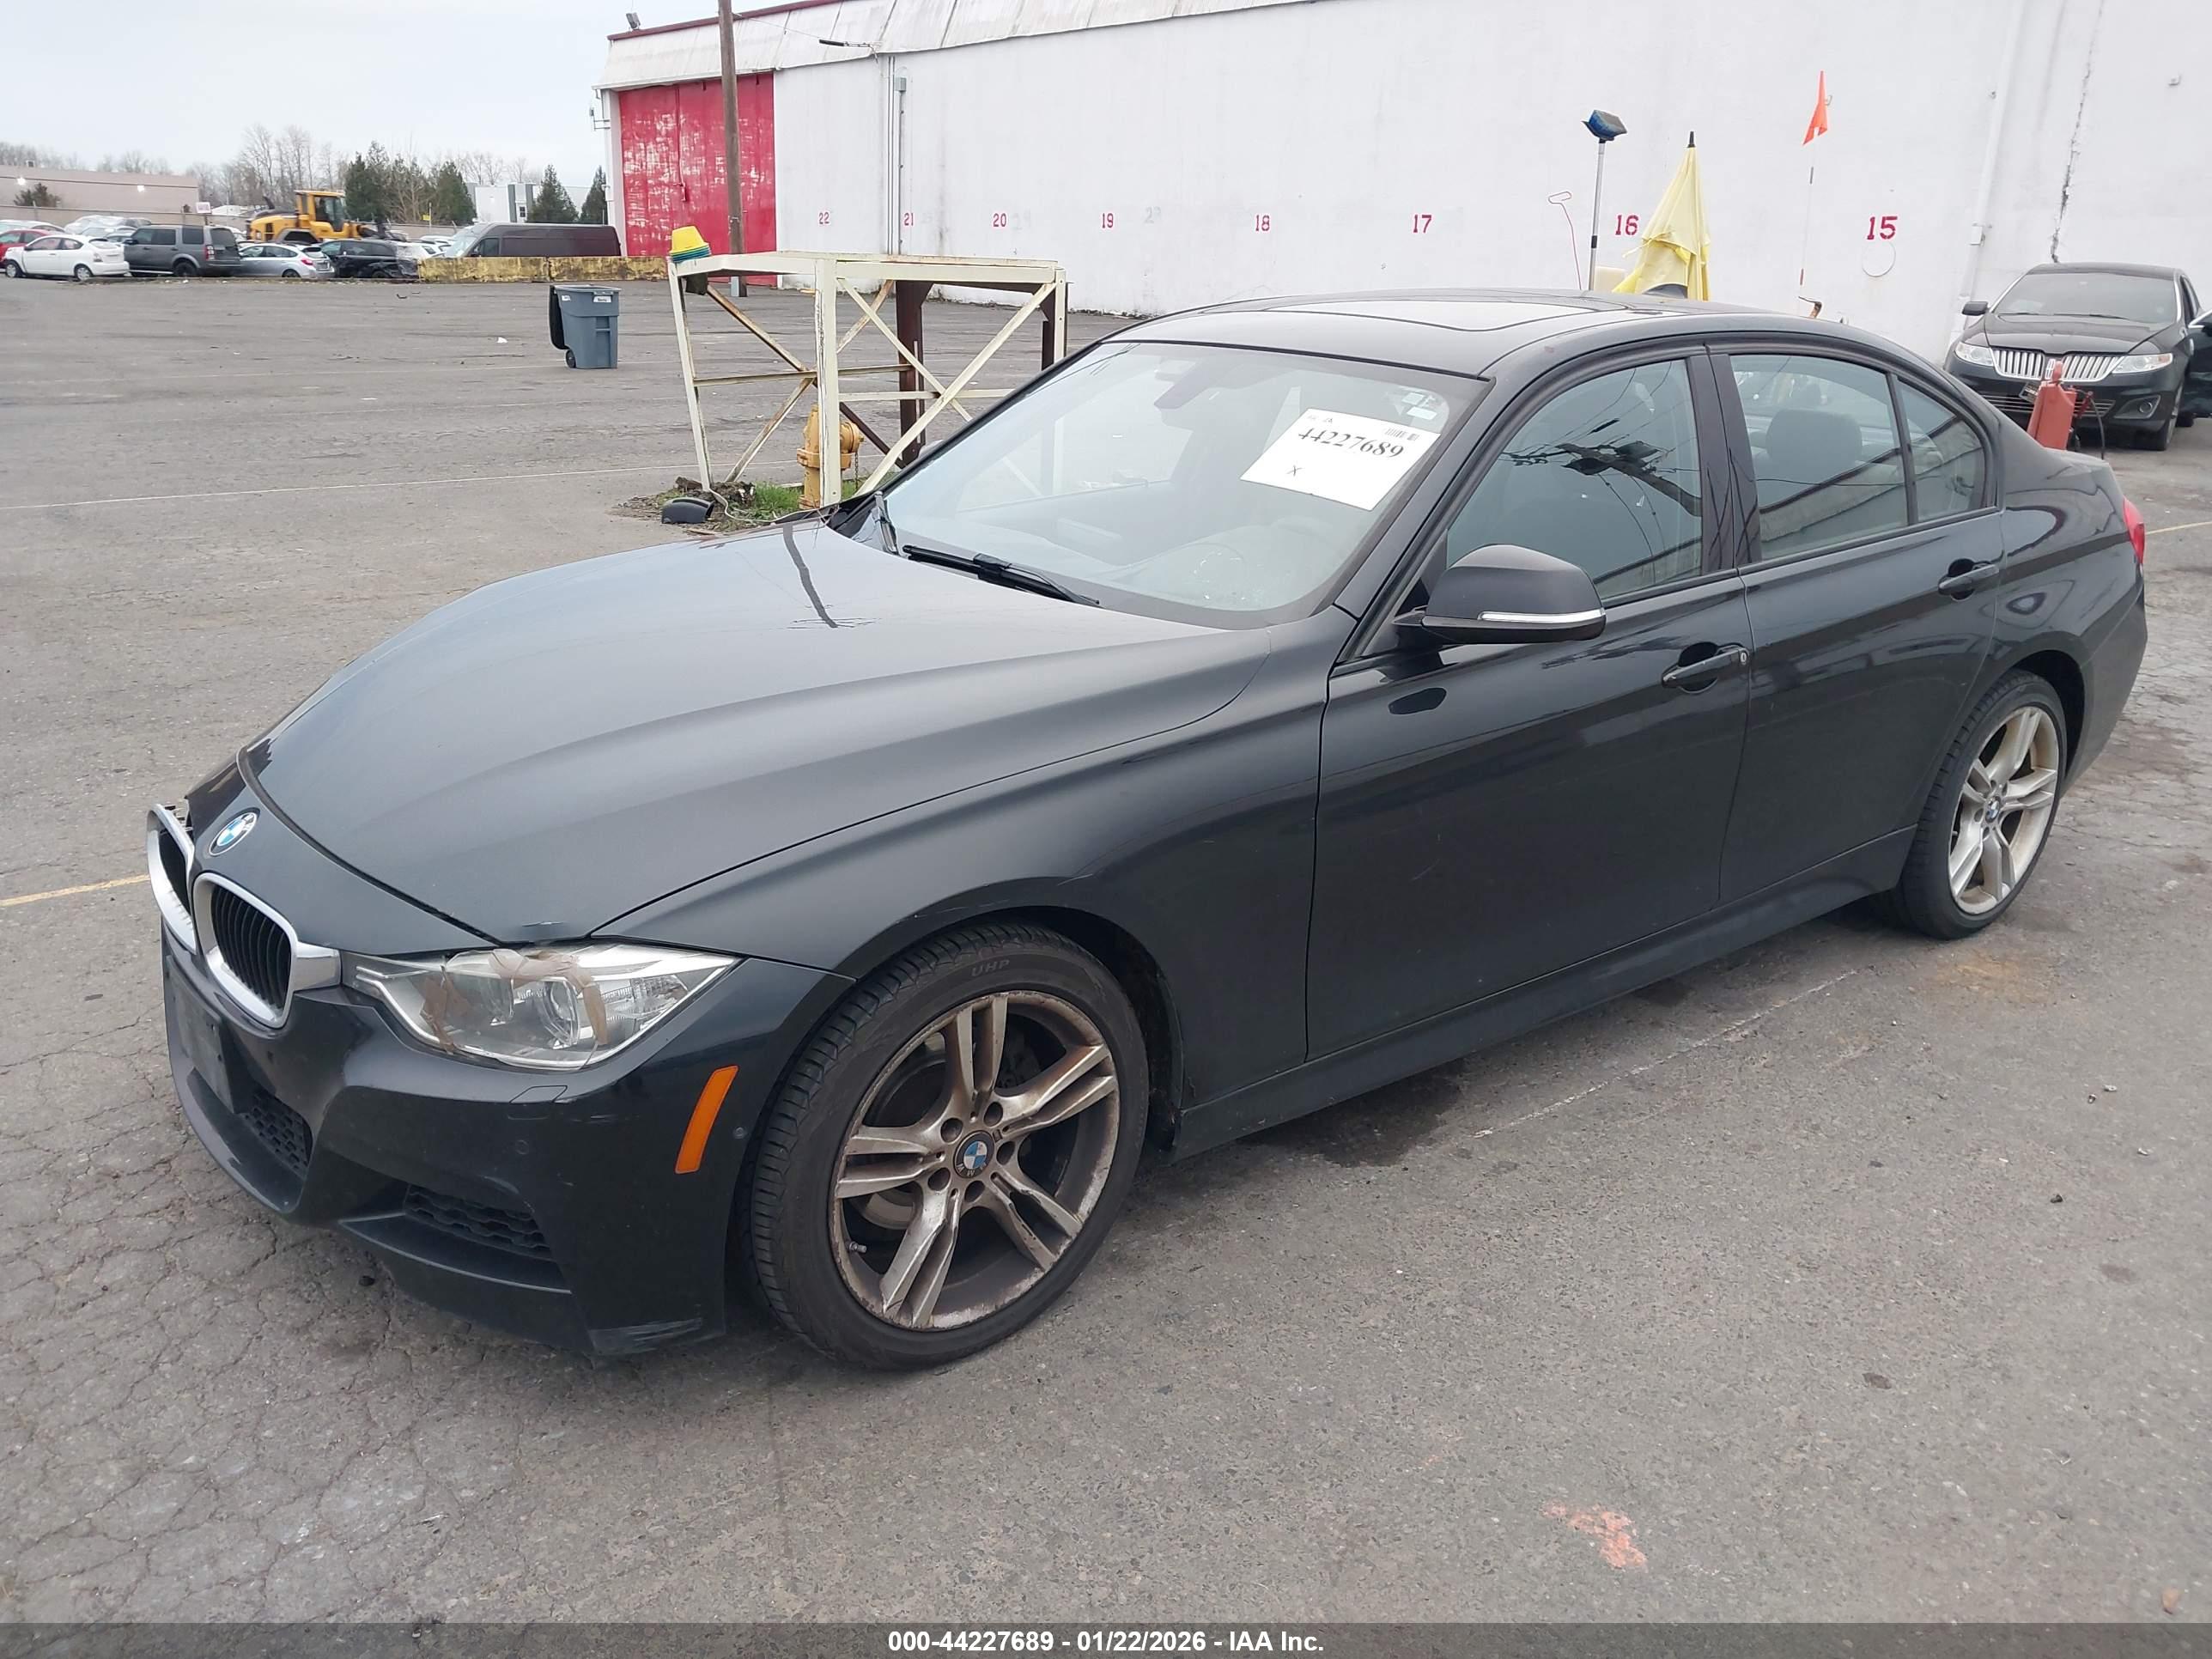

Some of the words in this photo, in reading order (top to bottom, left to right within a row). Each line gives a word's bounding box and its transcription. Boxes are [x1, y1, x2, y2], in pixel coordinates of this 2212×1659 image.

[818, 212, 830, 225] 22
[903, 212, 915, 226] 21
[993, 213, 1007, 228] 20
[1102, 213, 1115, 228] 19
[1255, 214, 1271, 232] 18
[1413, 214, 1432, 233] 17
[1614, 214, 1639, 235] 16
[1866, 216, 1898, 240] 15
[1298, 428, 1405, 459] 44227689
